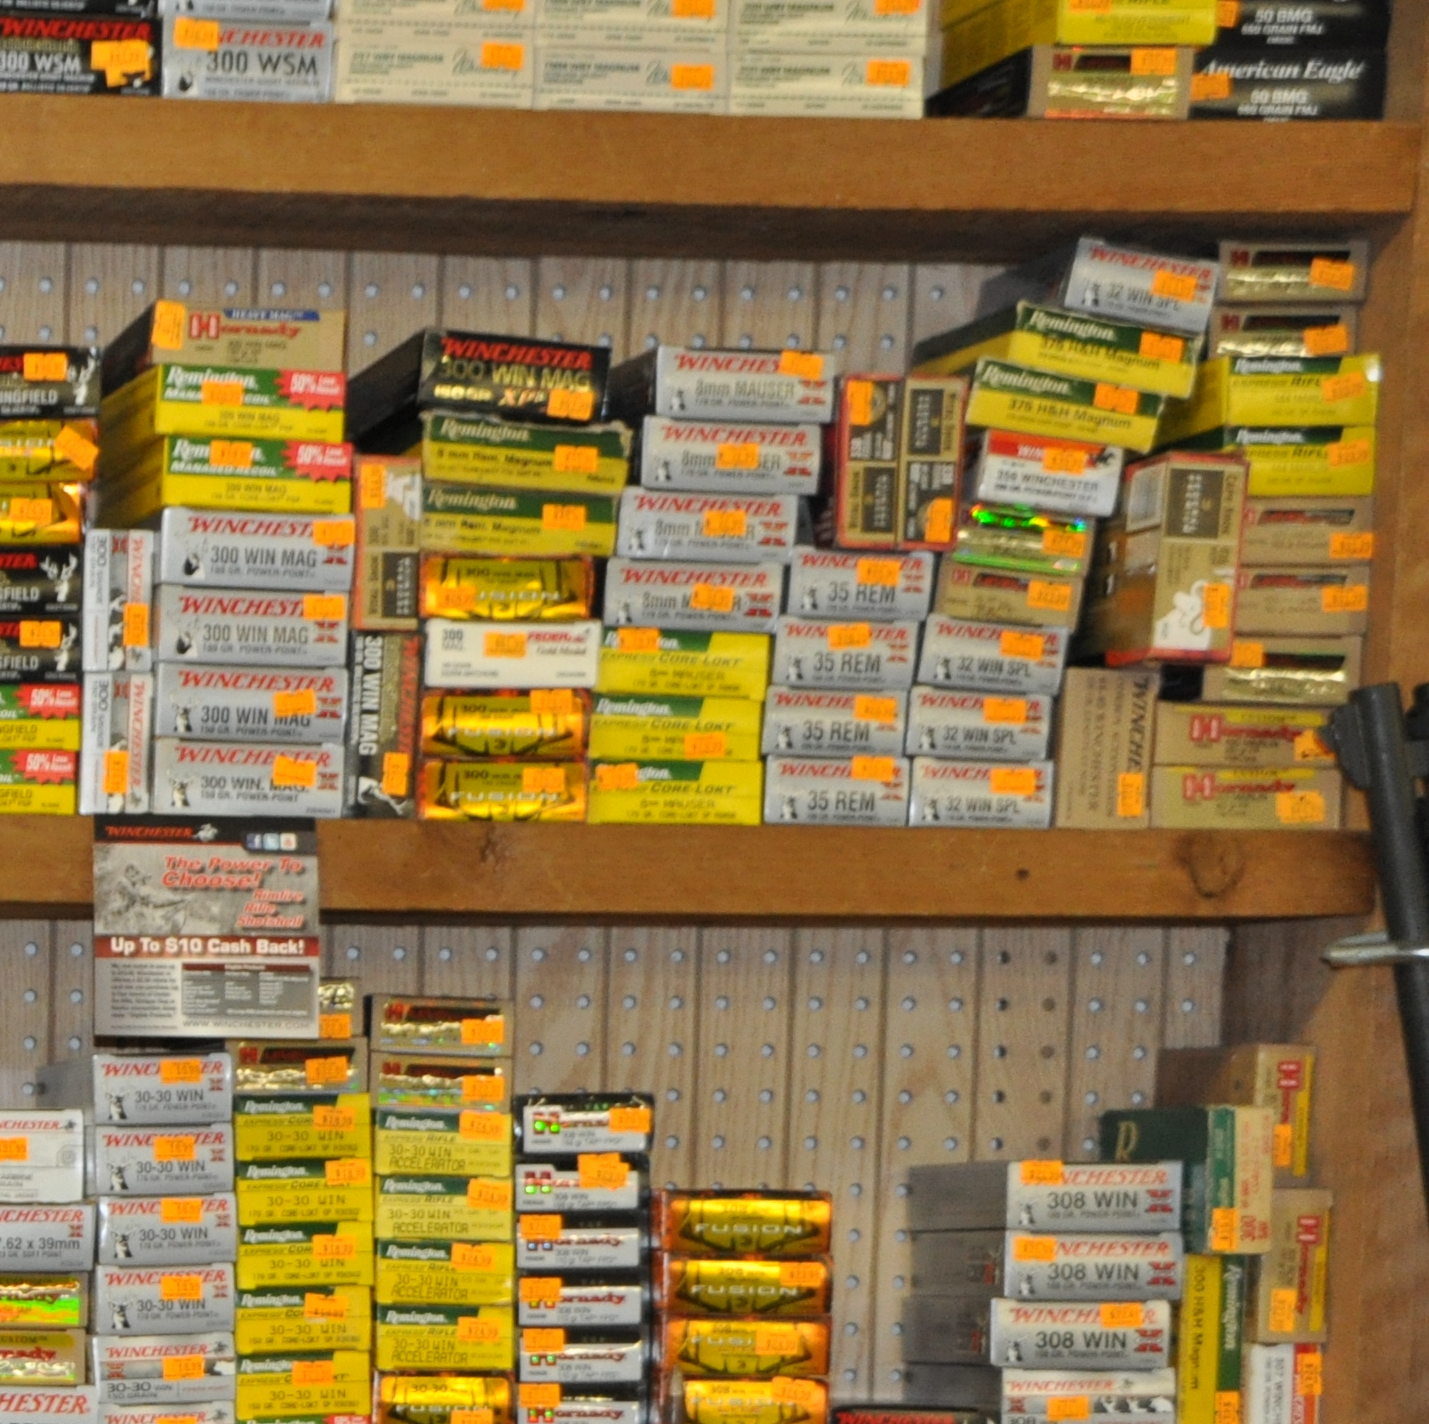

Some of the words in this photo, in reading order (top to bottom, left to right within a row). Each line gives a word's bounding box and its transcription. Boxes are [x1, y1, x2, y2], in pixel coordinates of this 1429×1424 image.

[206, 49, 248, 76] 300
[256, 49, 319, 77] WSM
[980, 361, 1070, 393] Remington
[619, 568, 769, 588] WINCHESTER
[202, 622, 230, 643] 300
[234, 623, 266, 644] WIN
[270, 624, 309, 645] MAG
[812, 652, 838, 672] 35
[841, 653, 881, 674] REM
[177, 667, 334, 693] WINCHESTER
[105, 825, 194, 837] WINCHESTER
[163, 855, 202, 871] The
[208, 856, 271, 872] Power
[279, 856, 303, 872] To
[161, 870, 262, 888] Choose!
[110, 936, 135, 956] Up
[141, 936, 160, 952] To
[164, 936, 202, 955] $10
[207, 937, 251, 955] Cash
[255, 938, 305, 956] Back!
[1048, 1190, 1091, 1210] 308
[1095, 1191, 1138, 1210] WIN
[392, 1220, 469, 1234] ACCELERATOR
[40, 1236, 81, 1251] 39mm
